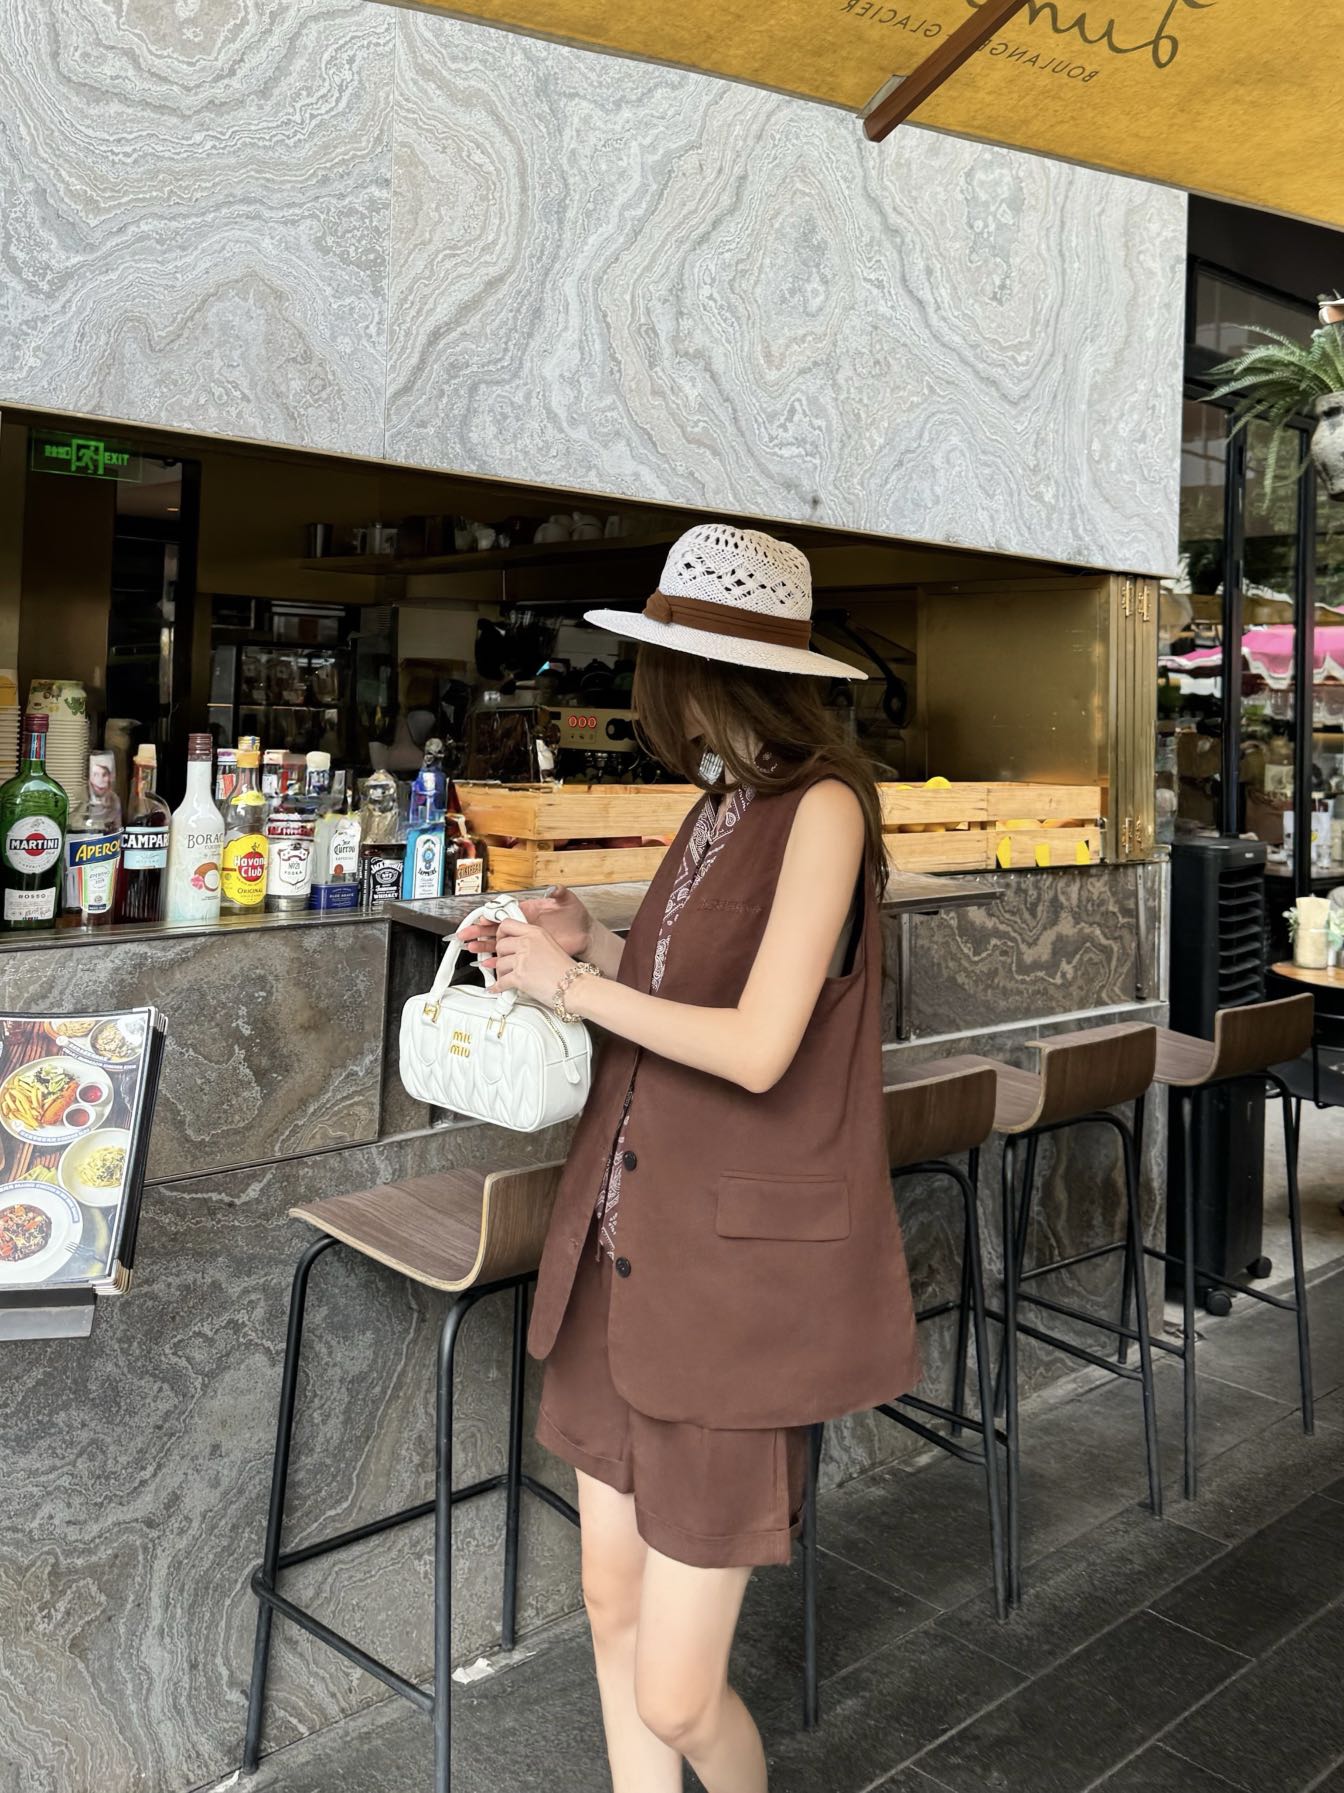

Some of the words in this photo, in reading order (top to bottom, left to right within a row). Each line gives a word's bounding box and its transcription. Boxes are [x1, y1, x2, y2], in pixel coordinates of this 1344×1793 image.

[104, 452, 129, 465] EXIT
[10, 838, 59, 850] MARTINI
[241, 866, 262, 878] Club
